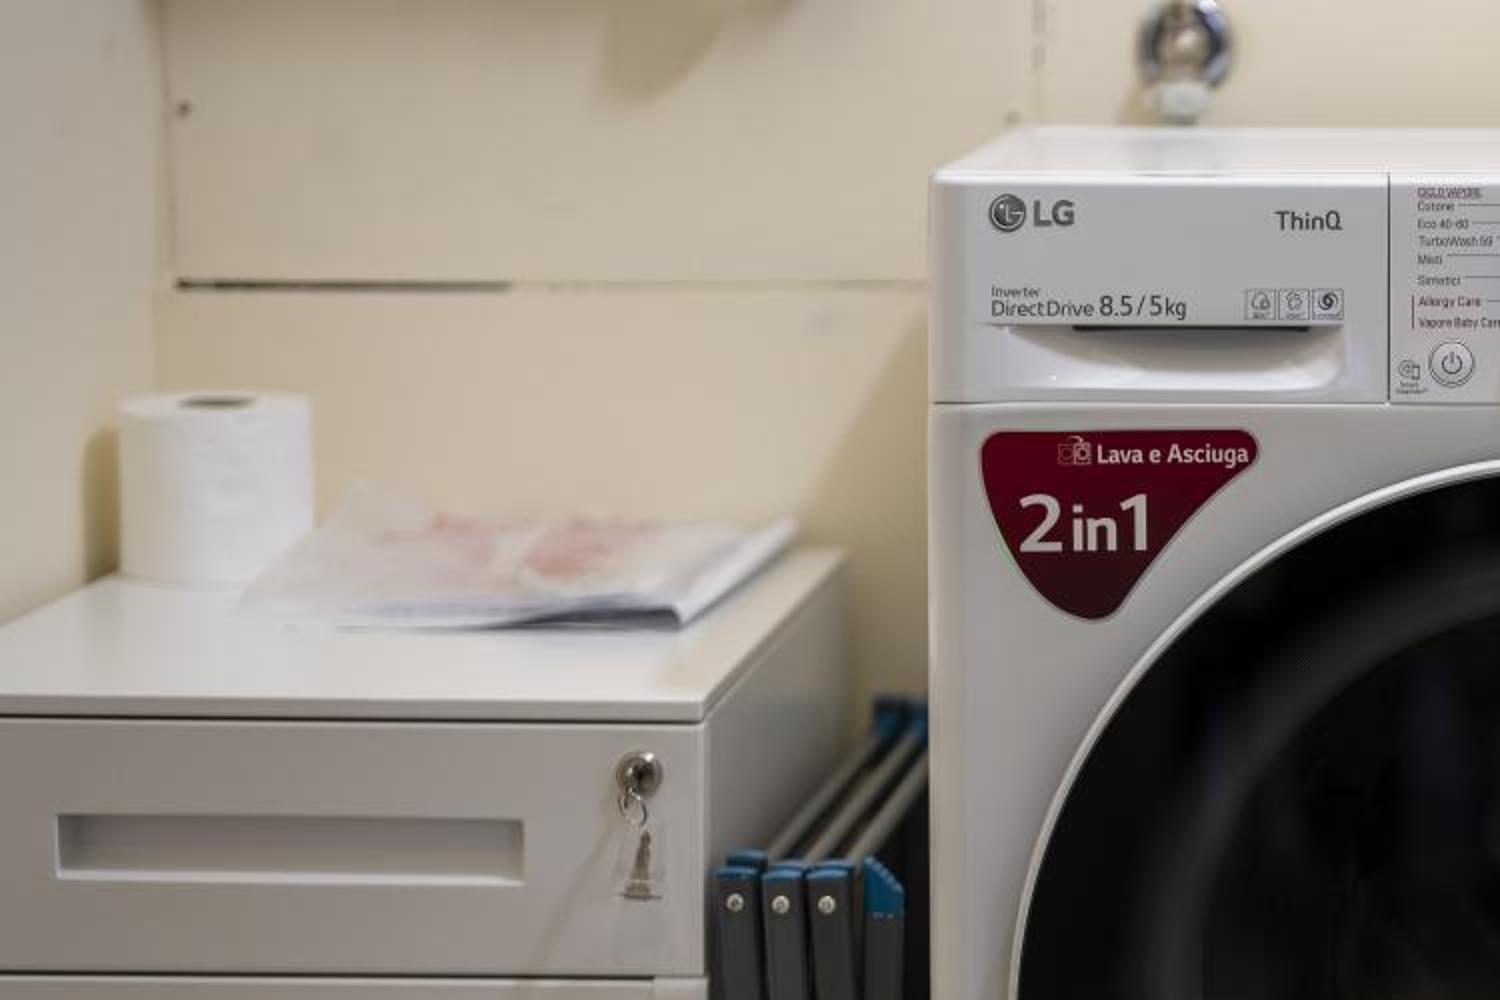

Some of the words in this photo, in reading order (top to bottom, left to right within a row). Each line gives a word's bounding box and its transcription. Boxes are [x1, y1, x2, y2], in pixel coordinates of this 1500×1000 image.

[1033, 199, 1075, 227] LG
[1273, 208, 1343, 231] ThinQ
[990, 285, 1042, 298] Inverter
[1097, 443, 1143, 464] Lava
[1150, 448, 1161, 464] e
[1167, 442, 1249, 468] Asciuga
